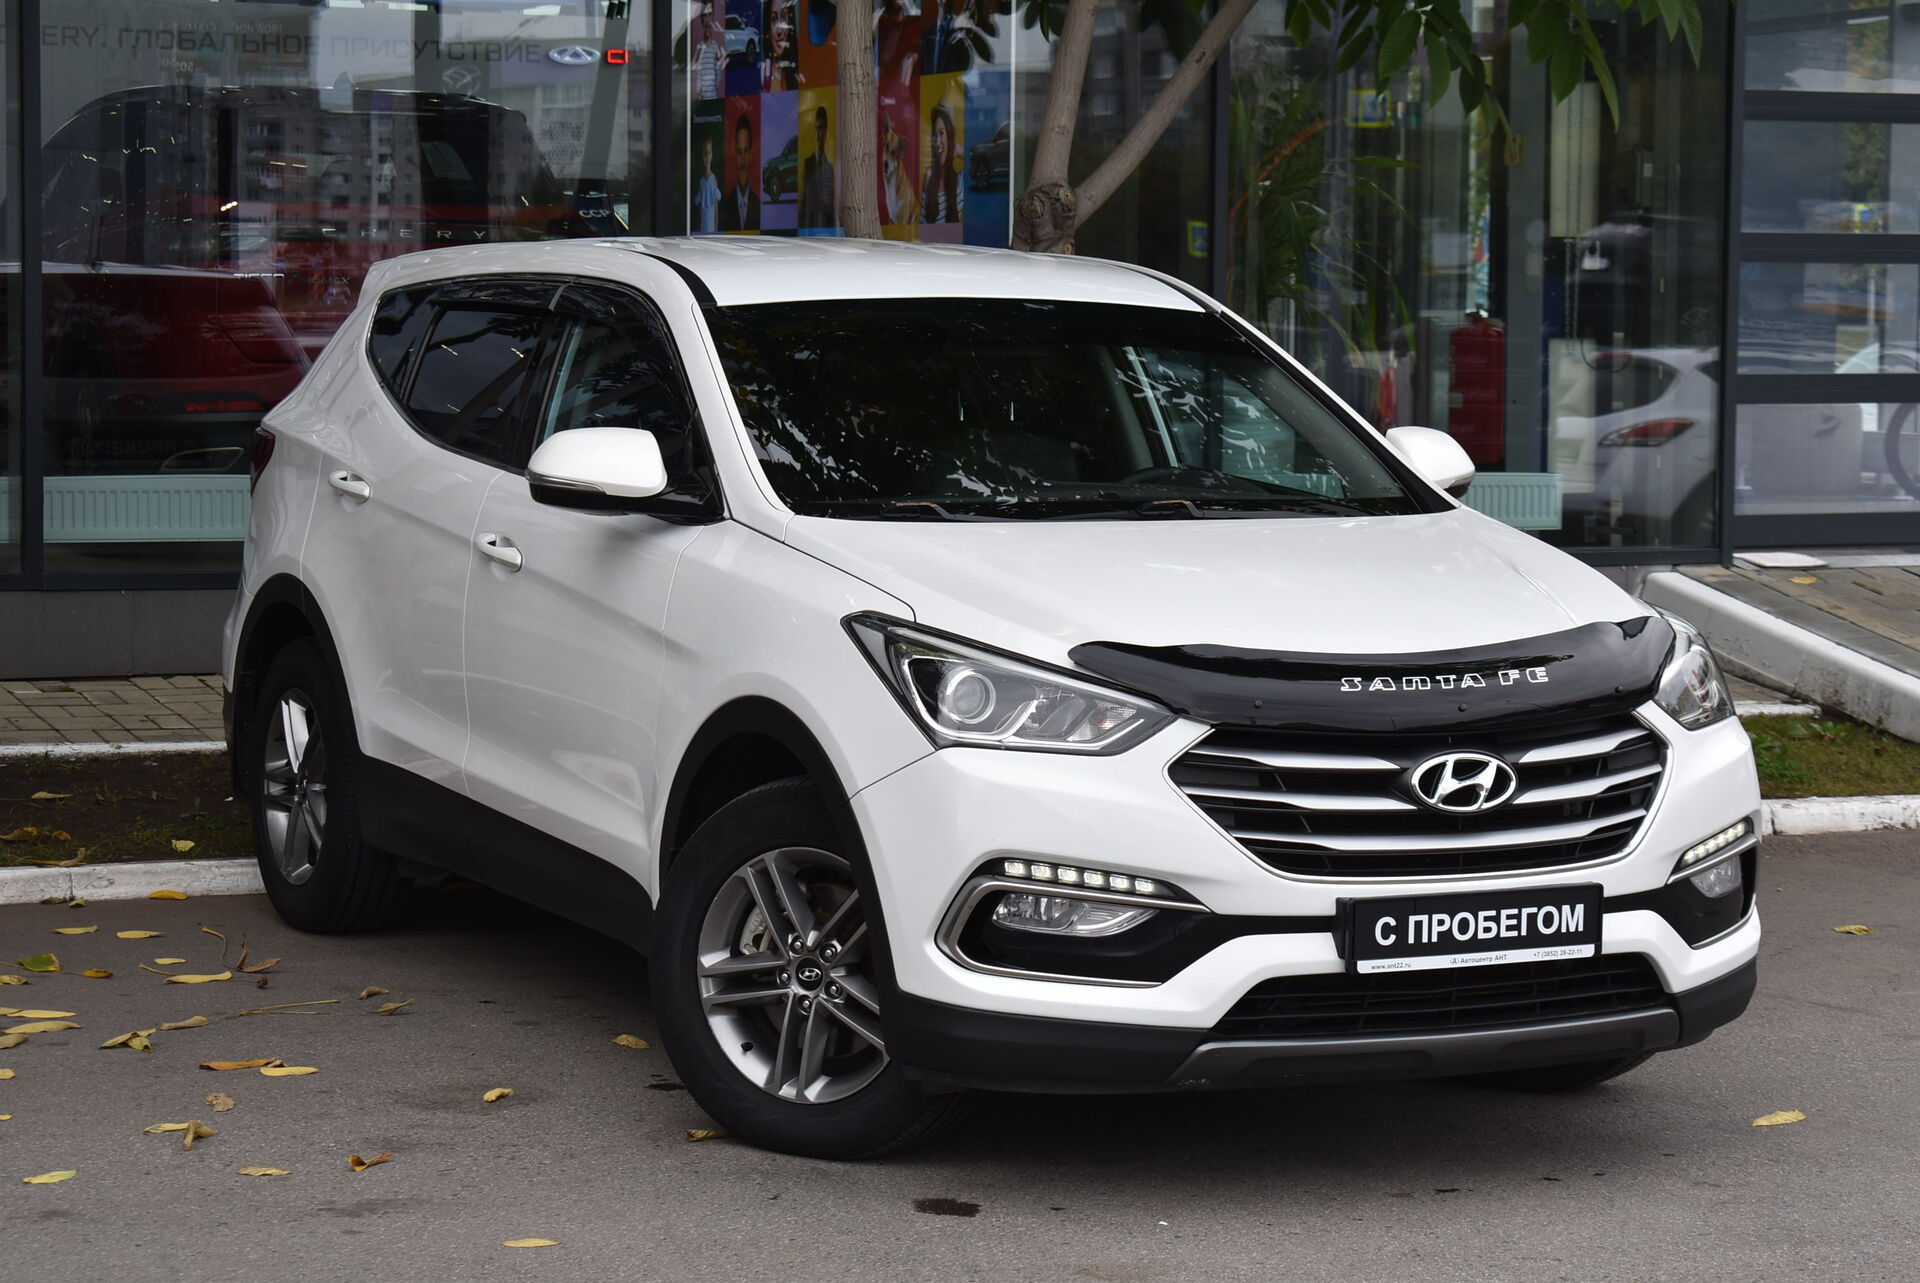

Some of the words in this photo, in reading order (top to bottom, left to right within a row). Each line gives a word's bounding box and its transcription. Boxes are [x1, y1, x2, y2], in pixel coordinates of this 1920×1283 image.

[118, 29, 320, 55] ГЛОБАЛЬНОЕ
[330, 37, 540, 63] ПРИСУТСТВИЕ
[322, 228, 487, 239] CHERY
[1341, 673, 1486, 692] SANTA
[1498, 667, 1549, 686] FE
[1375, 916, 1397, 946] С
[1408, 904, 1585, 944] ПРОБЕГОМ
[1460, 955, 1493, 964] Автоцентр
[1541, 950, 1559, 958] (3852)
[1371, 962, 1412, 970] www.ant22.ru
